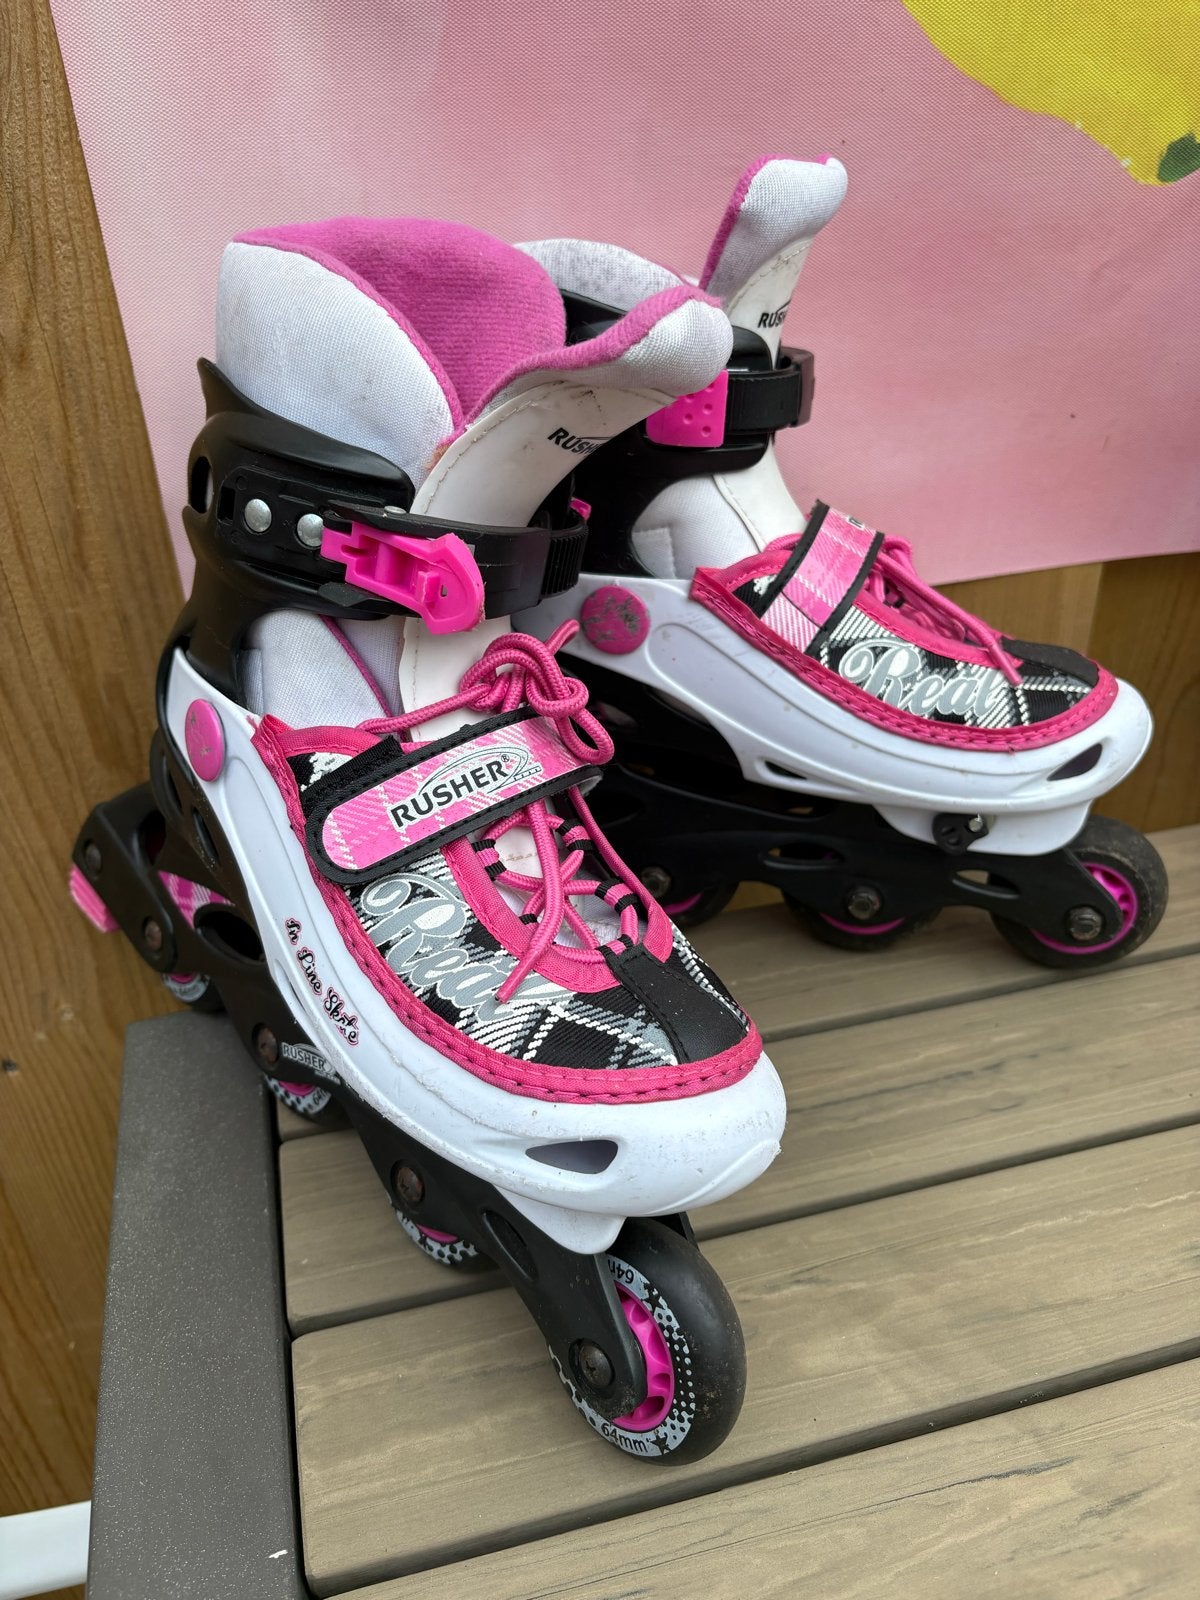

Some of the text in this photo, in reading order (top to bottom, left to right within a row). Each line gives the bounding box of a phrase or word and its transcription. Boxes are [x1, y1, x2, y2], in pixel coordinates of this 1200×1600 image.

[839, 638, 1012, 719] Real
[284, 918, 301, 944] In
[297, 948, 322, 994] Line
[281, 1042, 326, 1074] RUSHER
[600, 1422, 649, 1453] 64mm
